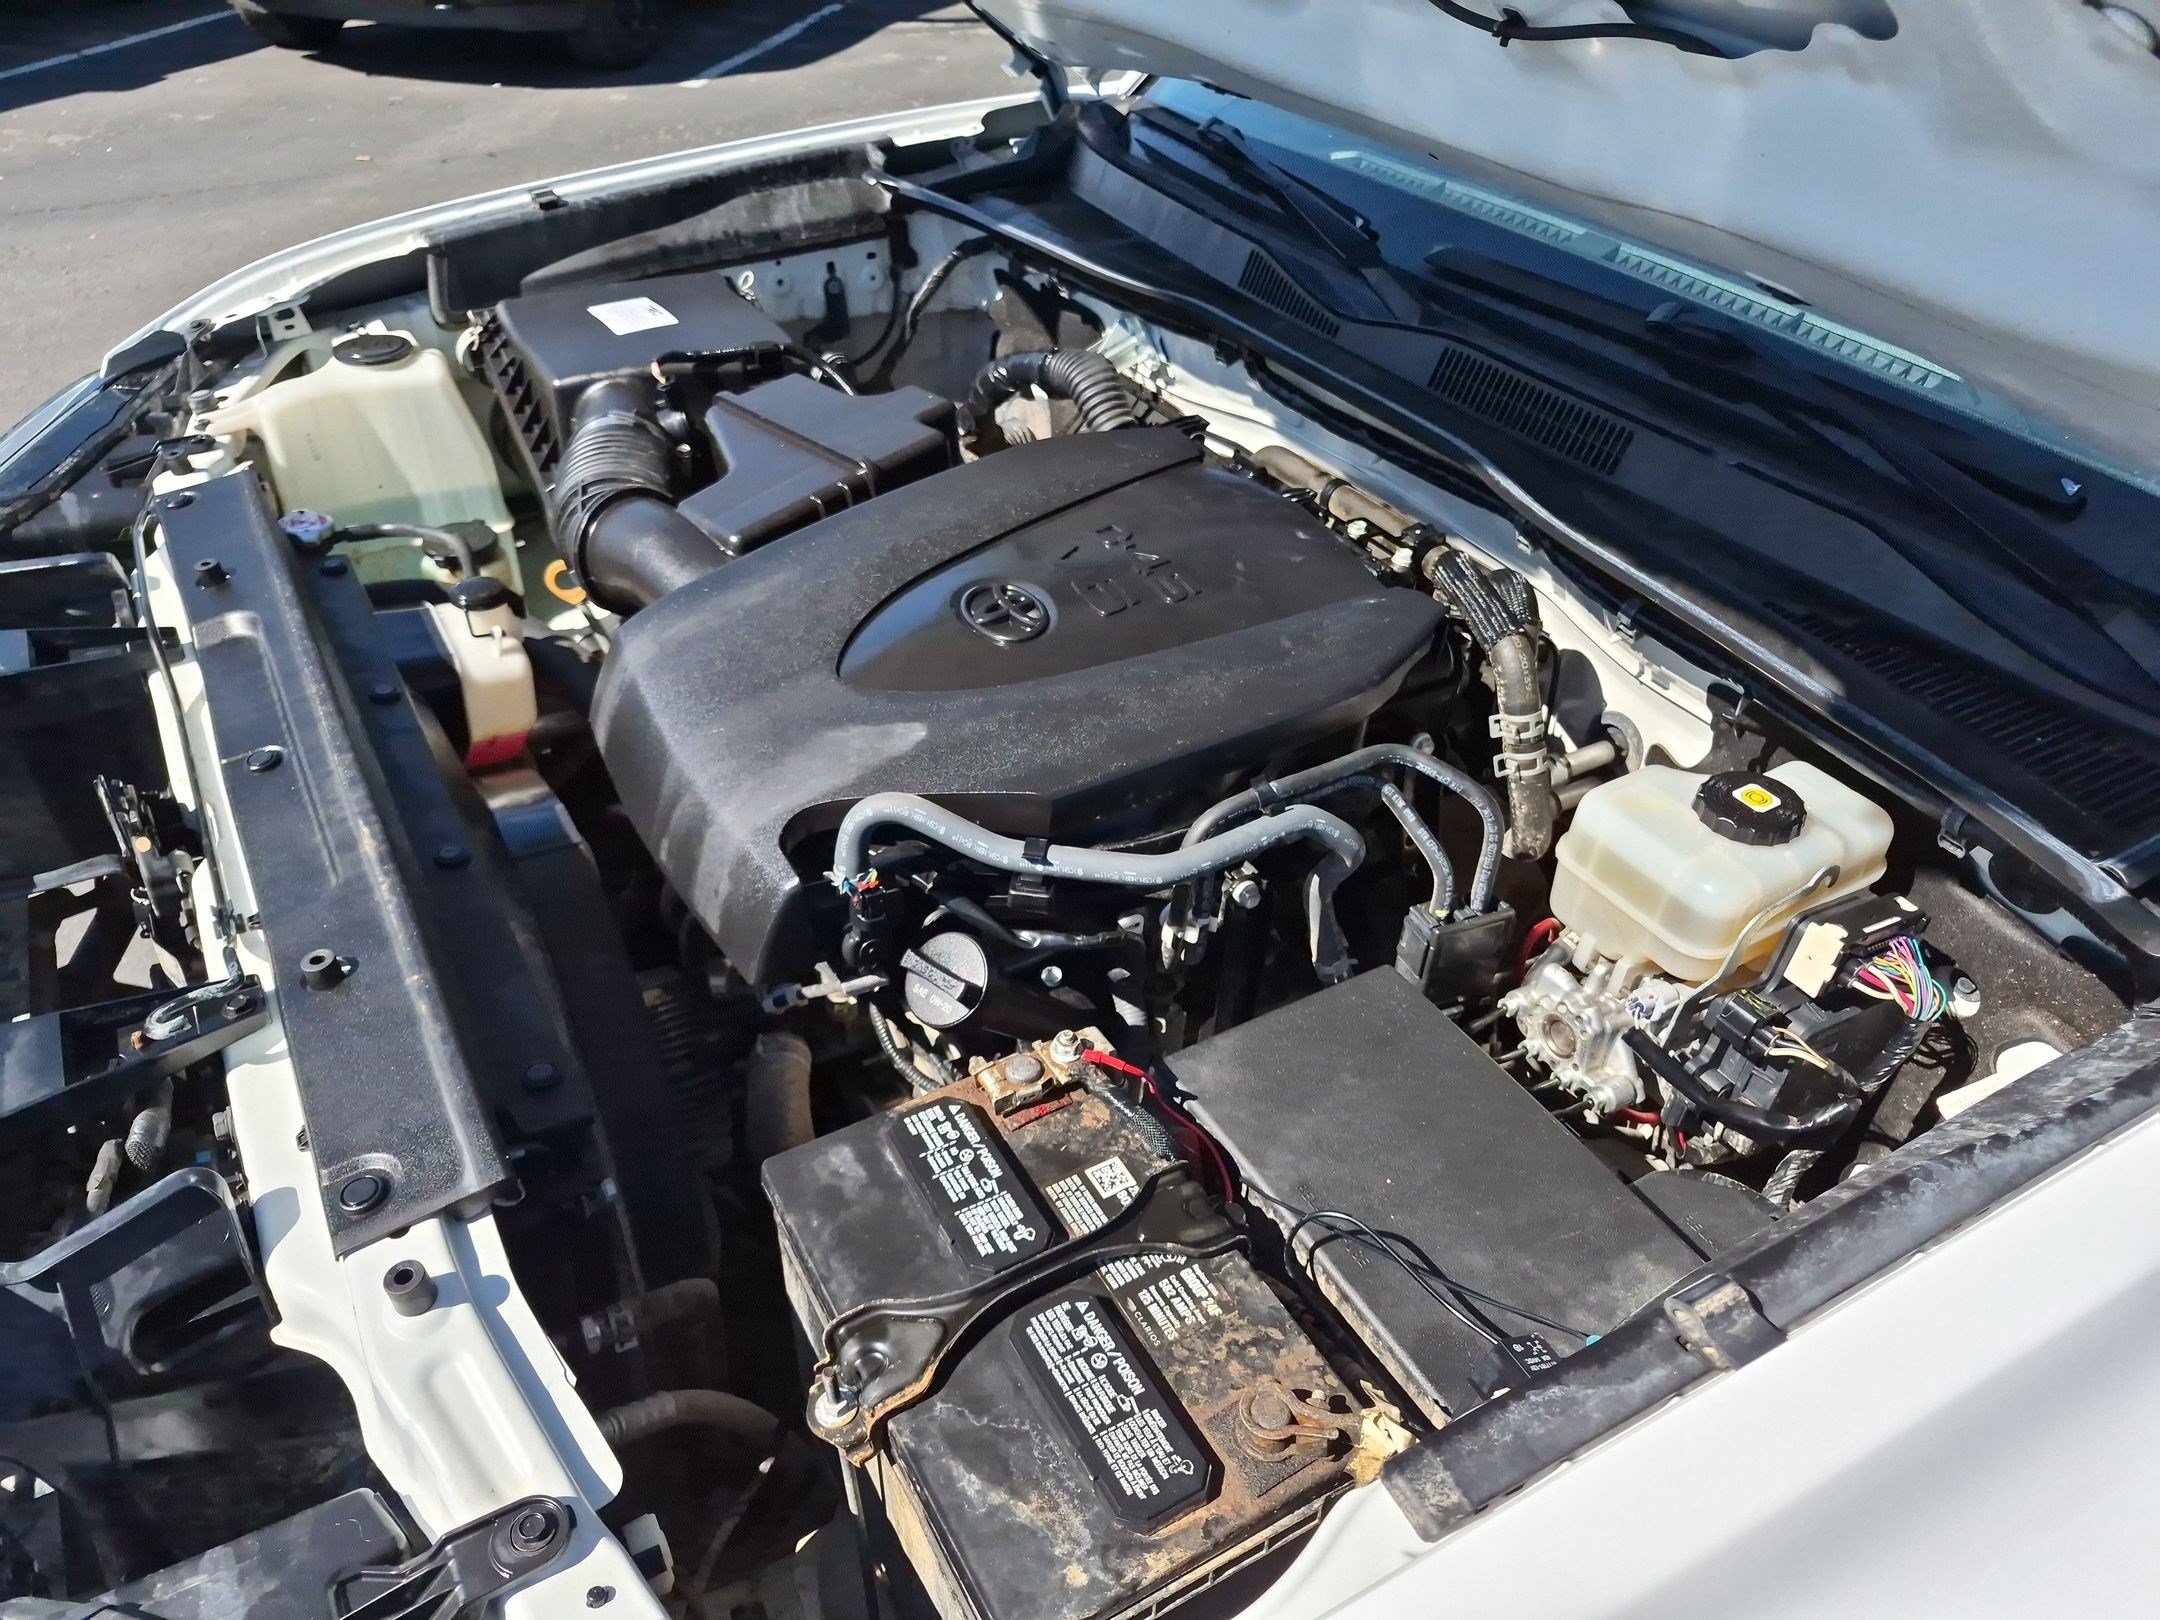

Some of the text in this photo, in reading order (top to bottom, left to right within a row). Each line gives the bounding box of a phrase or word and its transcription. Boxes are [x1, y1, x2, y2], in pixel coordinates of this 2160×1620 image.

[911, 982, 955, 1014] SAE 0W-20
[1137, 1288, 1154, 1305] 125
[1146, 1302, 1179, 1340] MINUTES
[1157, 1277, 1176, 1298] 582
[1169, 1296, 1196, 1325] AMPS
[1179, 1267, 1223, 1316] GROUP 24F
[1133, 1310, 1161, 1346] CLARIOS
